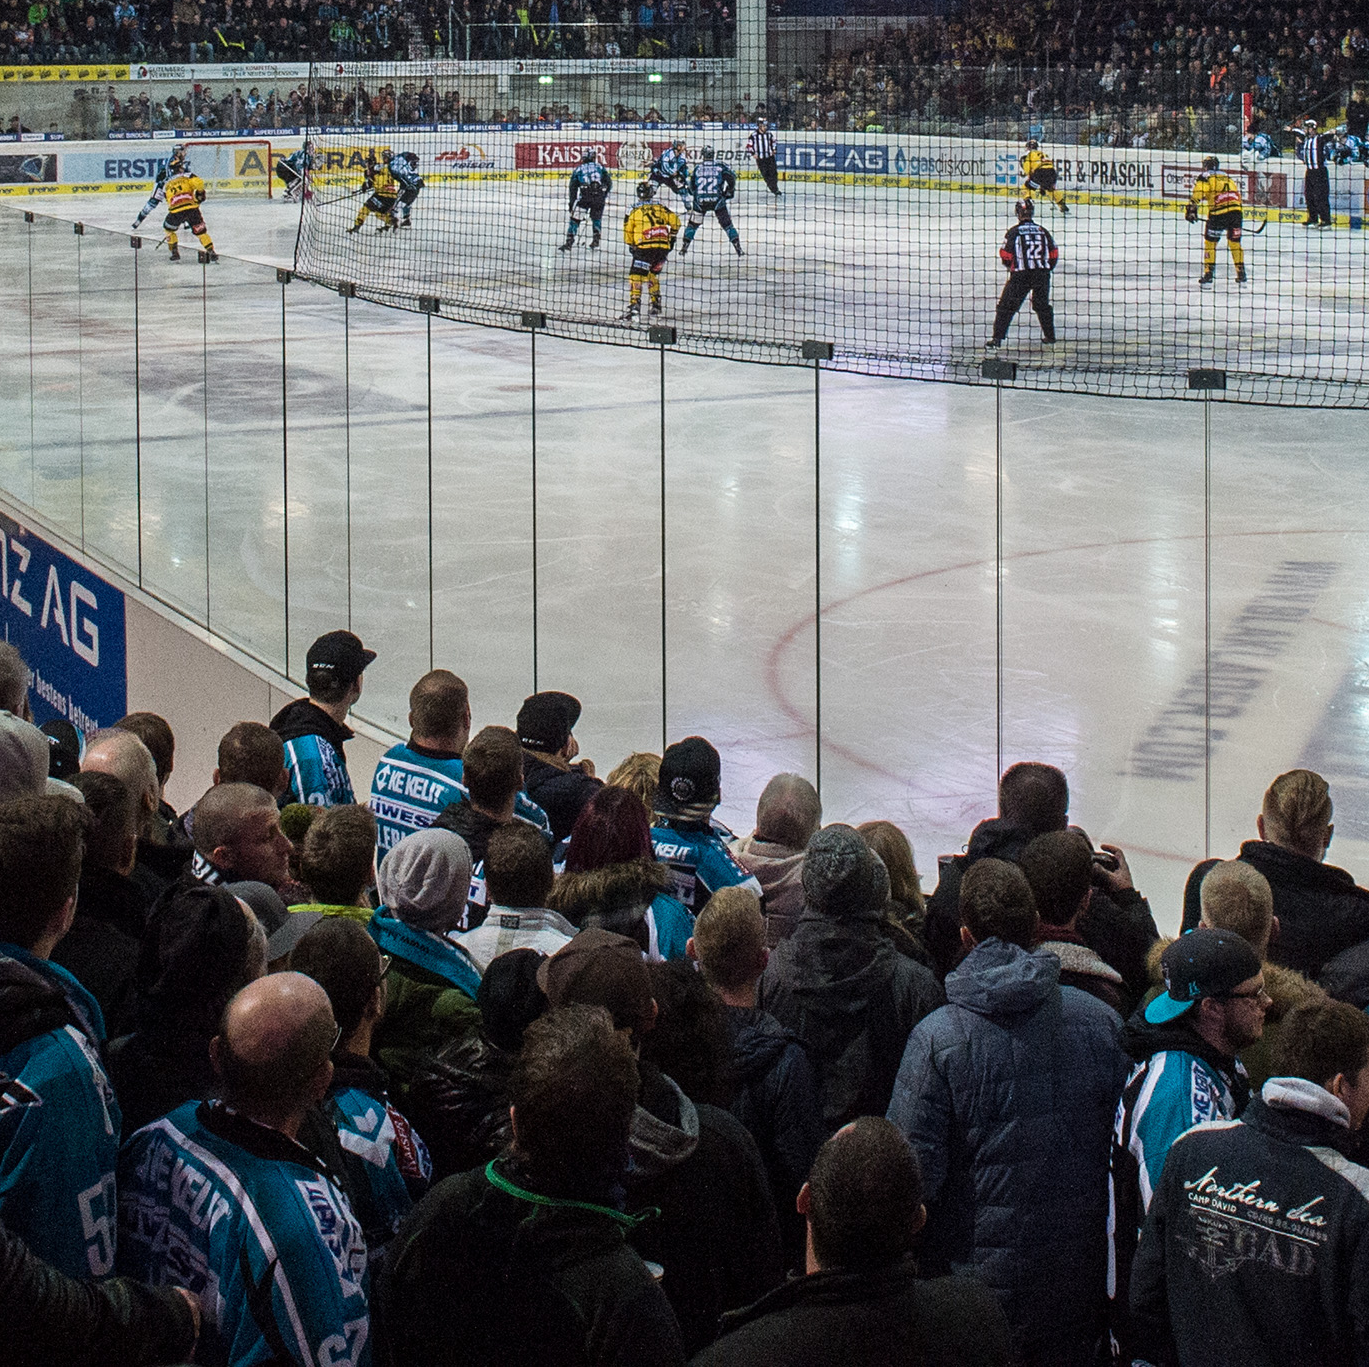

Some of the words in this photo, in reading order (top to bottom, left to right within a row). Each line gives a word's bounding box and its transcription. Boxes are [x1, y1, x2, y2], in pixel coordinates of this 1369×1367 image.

[844, 149, 883, 168] AG
[910, 153, 986, 177] gasdiskont
[116, 182, 148, 191] greiner
[1090, 162, 1155, 189] PRASCHL
[28, 186, 60, 195] greiner
[72, 184, 103, 193] greiner
[1026, 240, 1043, 259] 22
[40, 564, 99, 668] AG
[36, 668, 67, 717] bestens
[389, 766, 409, 794] KE
[404, 774, 445, 805] KELIT
[370, 798, 437, 828] LIWES
[1184, 1165, 1280, 1213] Northern
[1286, 1195, 1327, 1227] Sea
[1188, 1192, 1211, 1205] CAMP
[1211, 1197, 1237, 1214] DAVID
